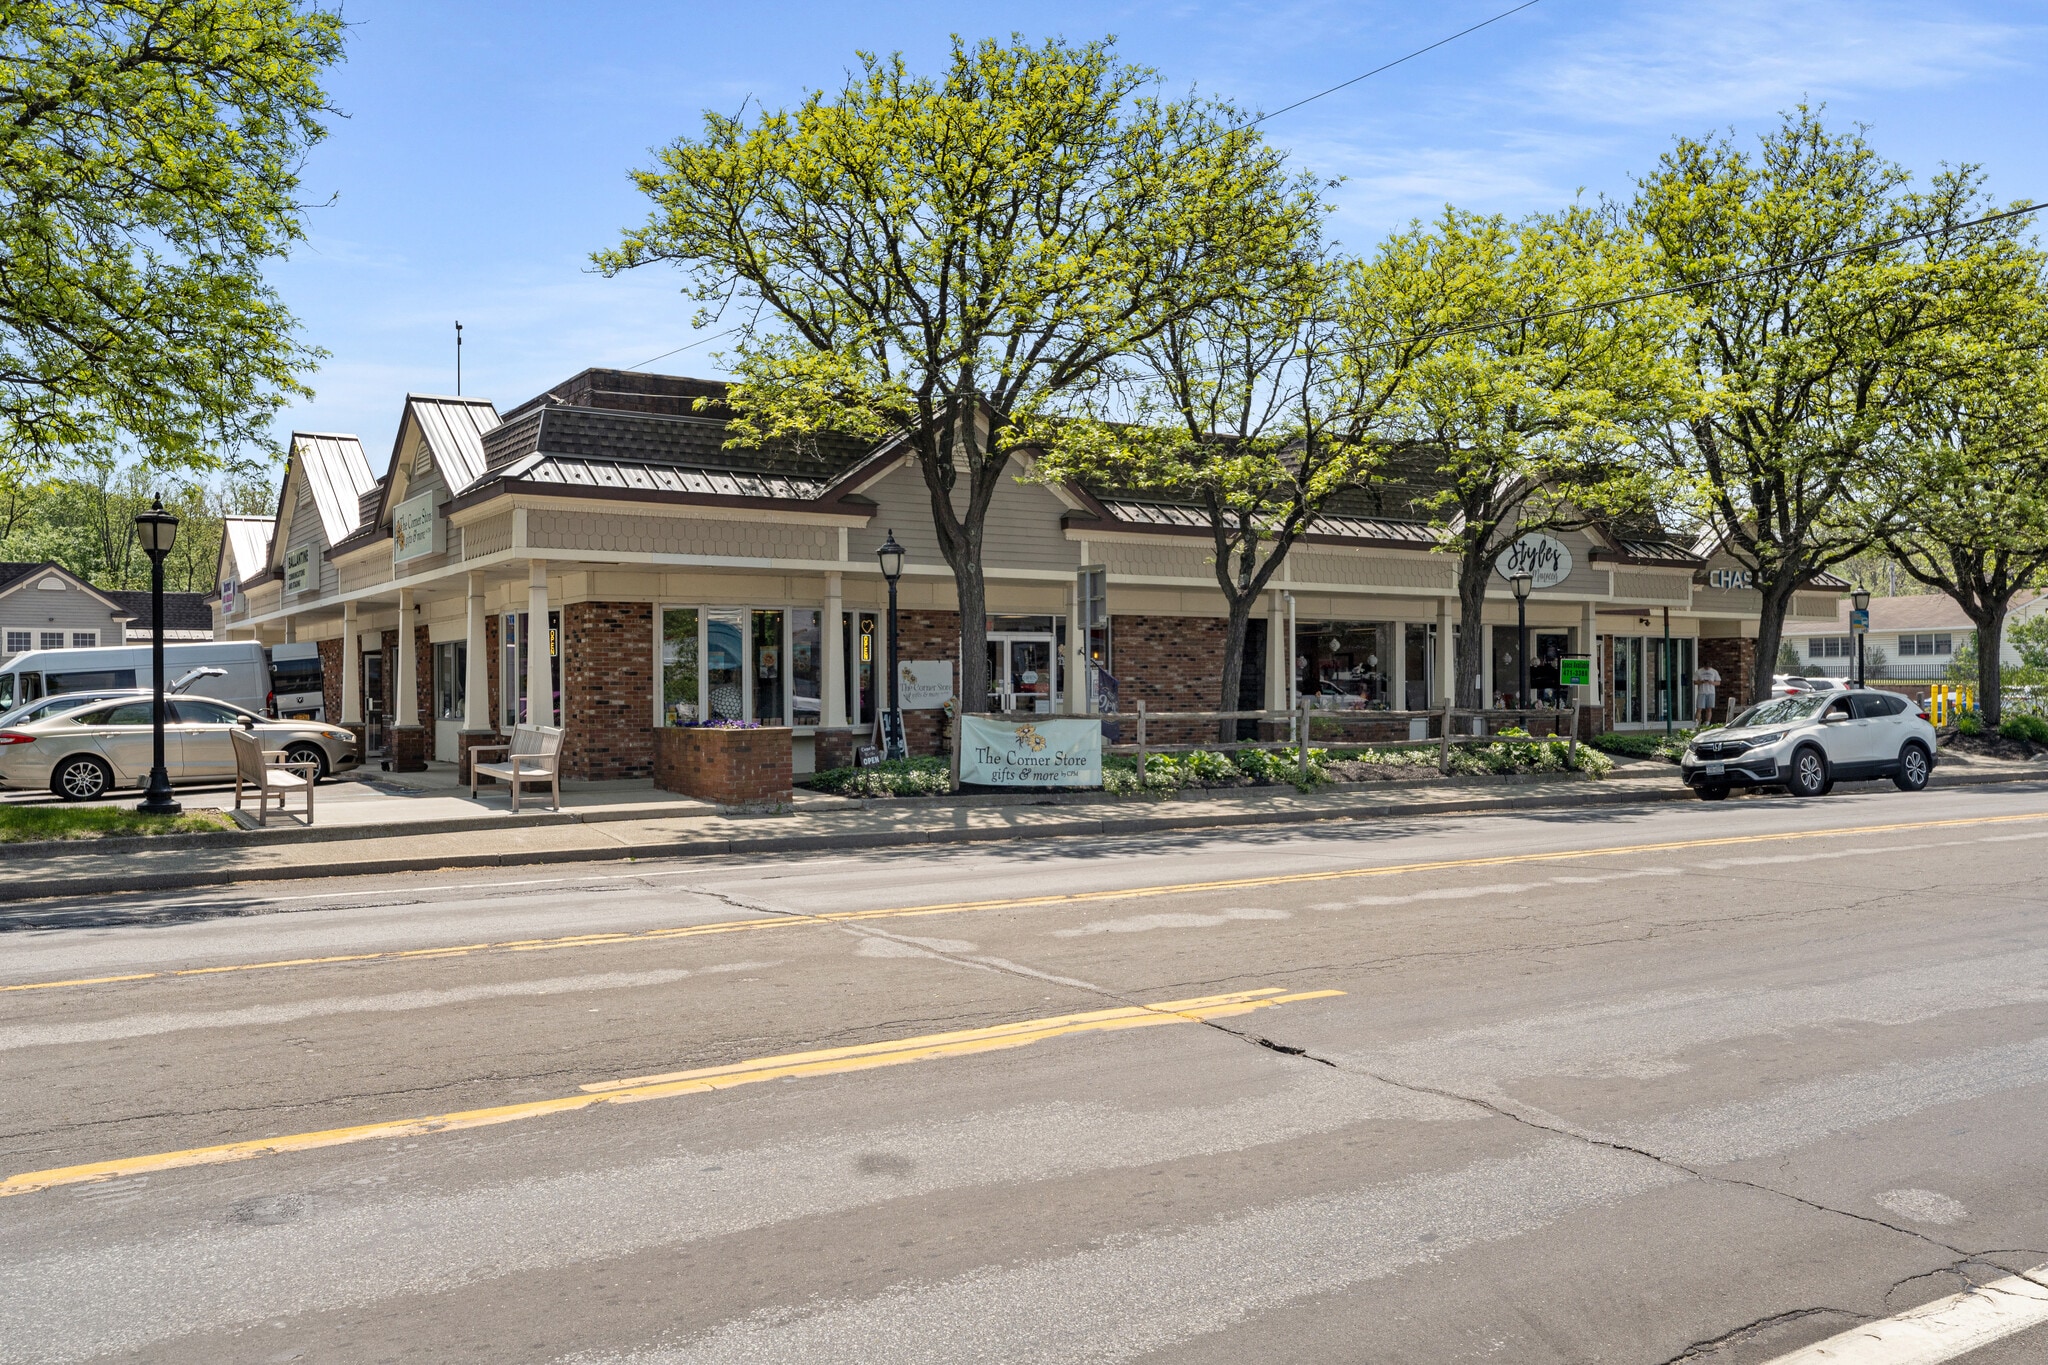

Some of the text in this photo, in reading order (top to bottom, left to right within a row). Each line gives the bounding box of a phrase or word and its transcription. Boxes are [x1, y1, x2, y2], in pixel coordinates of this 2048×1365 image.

[400, 513, 408, 531] The
[408, 513, 422, 529] Corner
[422, 507, 432, 525] Store
[288, 549, 309, 569] BALLANTINE
[1508, 540, 1561, 571] Styles
[901, 683, 912, 691] The
[863, 755, 880, 766] OPEN
[976, 746, 1087, 766] The Corner Store
[991, 767, 1015, 782] gifts
[1019, 767, 1032, 780] &
[1032, 771, 1059, 781] more
